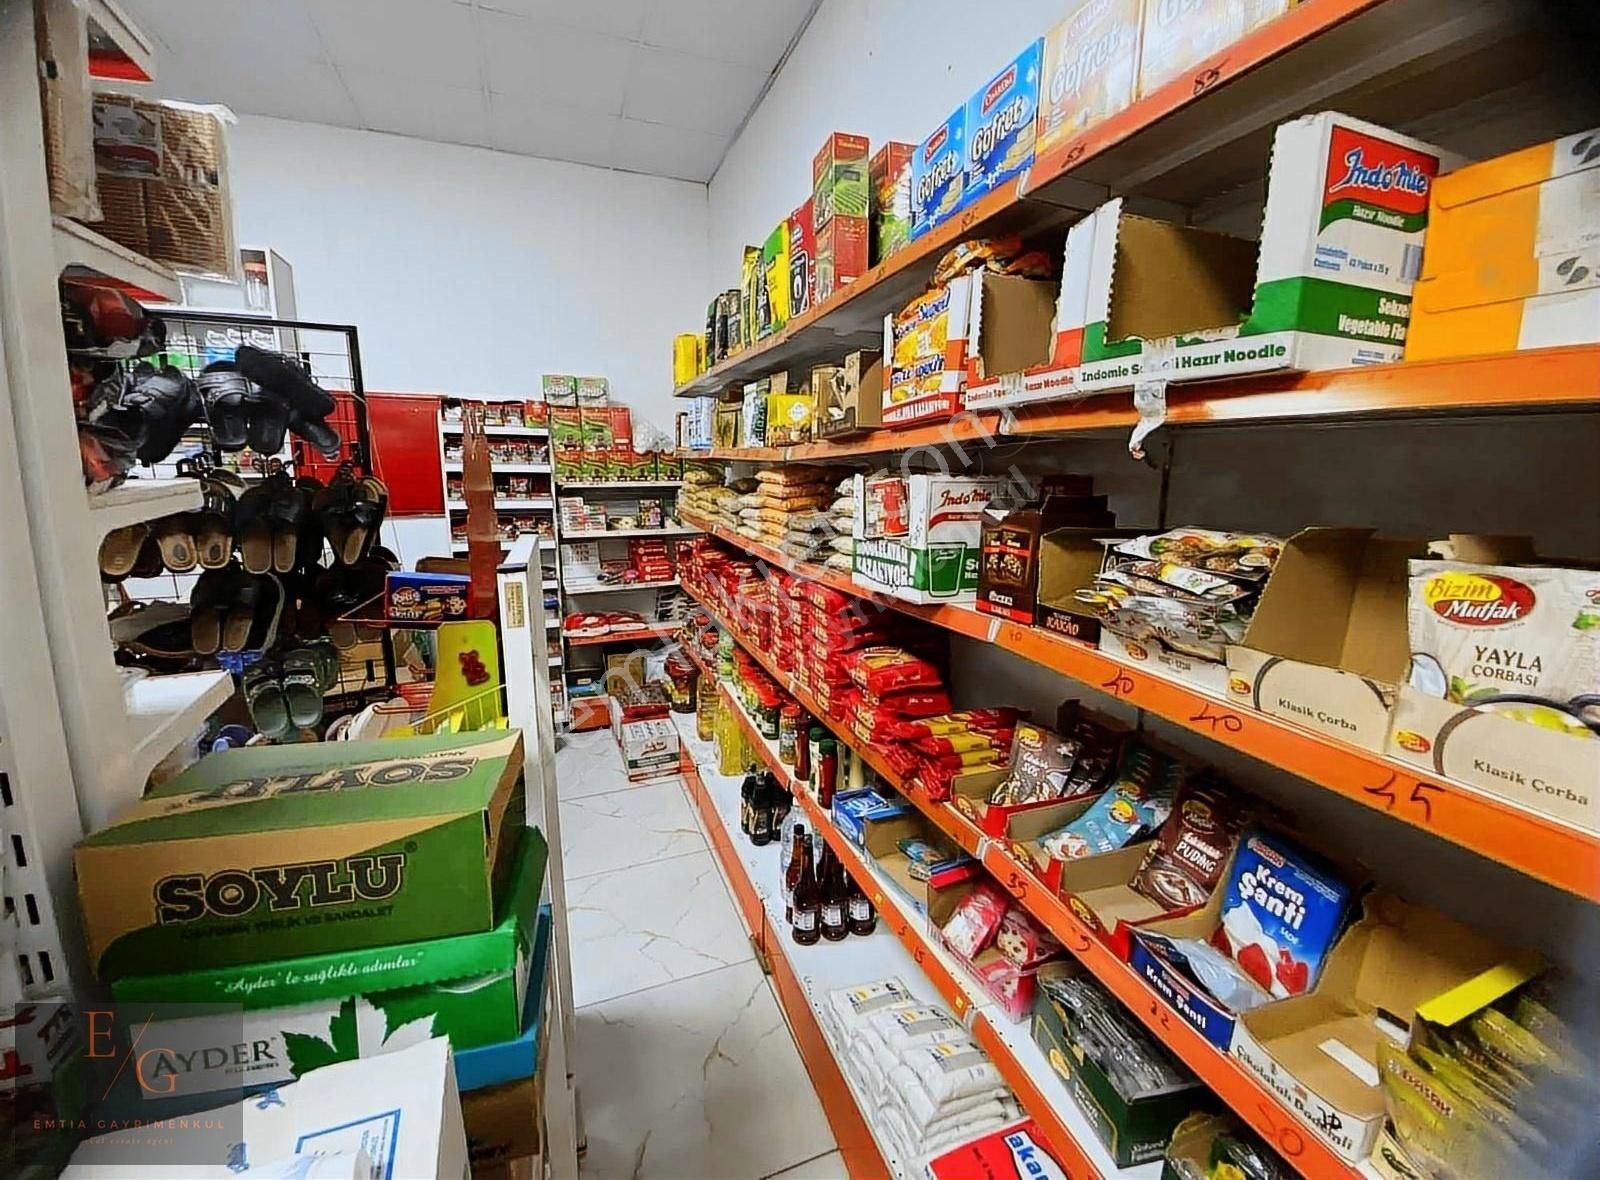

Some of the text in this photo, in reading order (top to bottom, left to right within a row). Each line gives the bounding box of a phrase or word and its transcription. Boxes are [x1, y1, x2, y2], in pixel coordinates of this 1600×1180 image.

[972, 95, 1023, 162] Gofret
[917, 150, 954, 205] Gofret
[1081, 367, 1130, 383] Indomie
[1182, 353, 1221, 371] Hazır
[1224, 343, 1288, 364] Noodle
[1428, 577, 1494, 599] Bizim
[1045, 615, 1080, 636] KAKAO
[1443, 599, 1522, 622] Mutfak
[1475, 645, 1543, 674] YAYLA
[1189, 702, 1244, 733] 40
[1278, 697, 1358, 733] Klasik Çorba
[1473, 758, 1590, 807] Klasik Çorba
[154, 853, 406, 926] SOYLU
[1238, 871, 1306, 930] Şanti
[1256, 864, 1304, 906] Krem
[1146, 965, 1173, 999] Krem
[153, 1038, 277, 1080] AYDER
